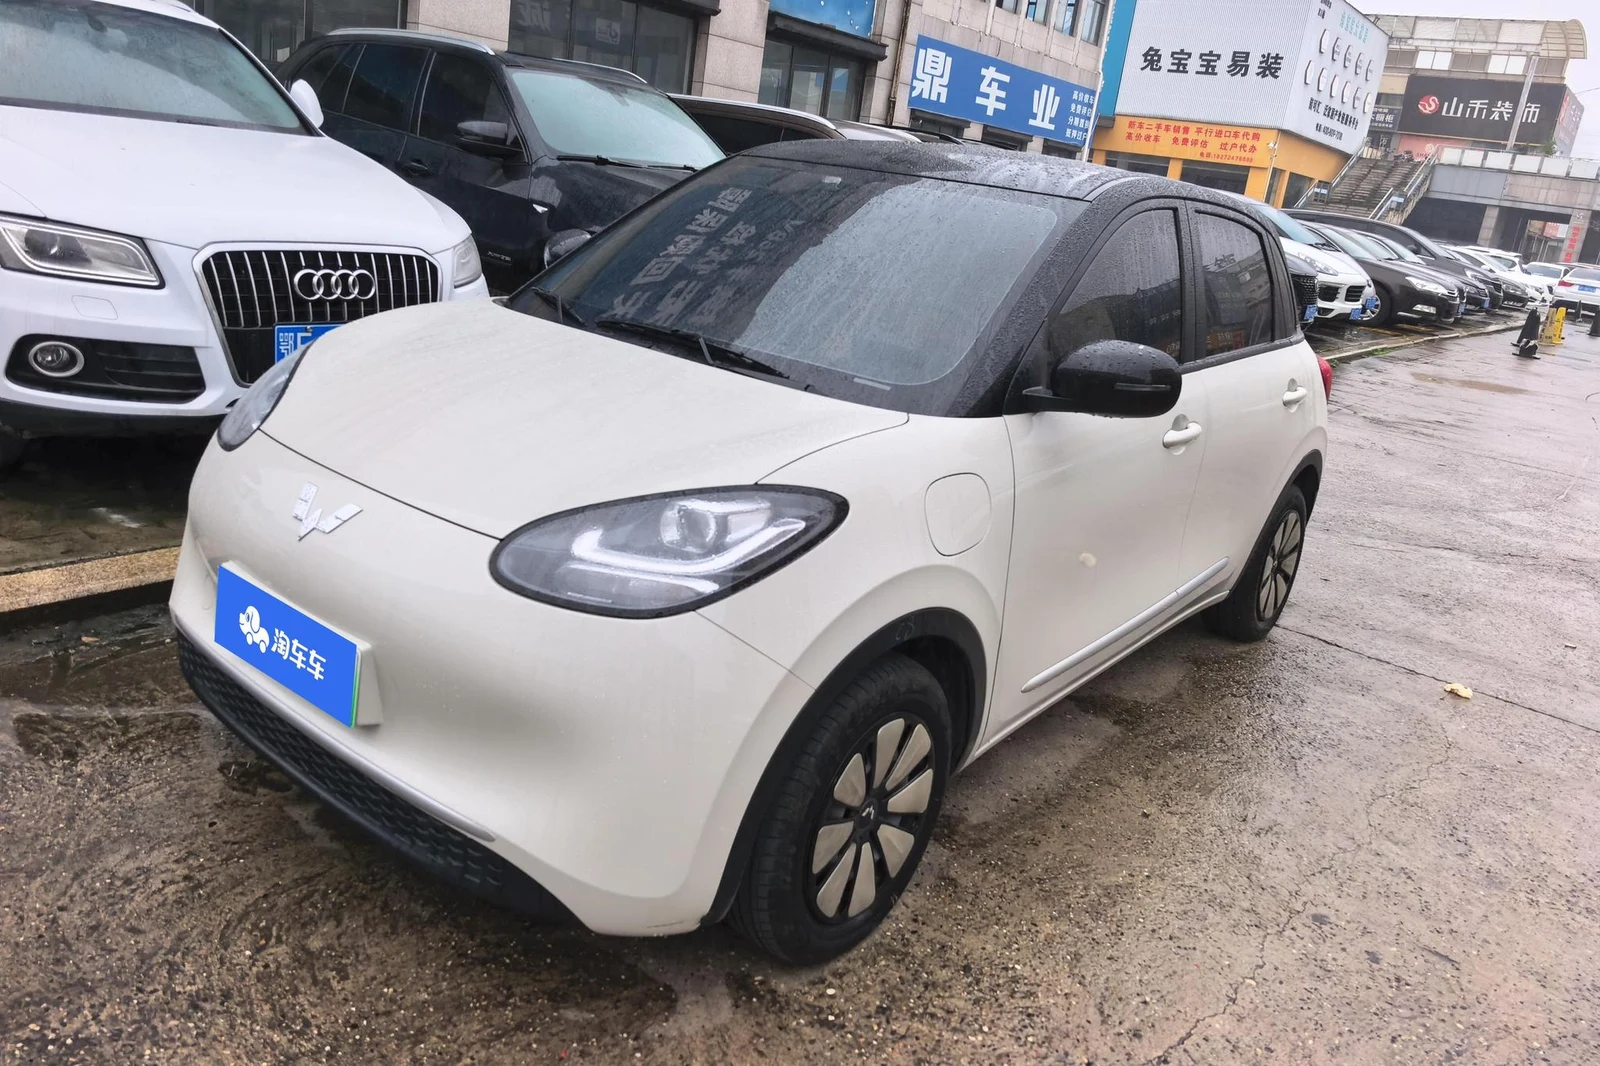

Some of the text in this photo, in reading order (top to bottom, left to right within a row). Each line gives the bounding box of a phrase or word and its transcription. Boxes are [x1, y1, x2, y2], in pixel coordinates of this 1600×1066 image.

[1140, 46, 1284, 80] 兔宝宝易装
[1125, 131, 1257, 154] 高价收车 免费评估 过户代办
[1127, 120, 1261, 142] 新车二手车销售 平行进口车代购
